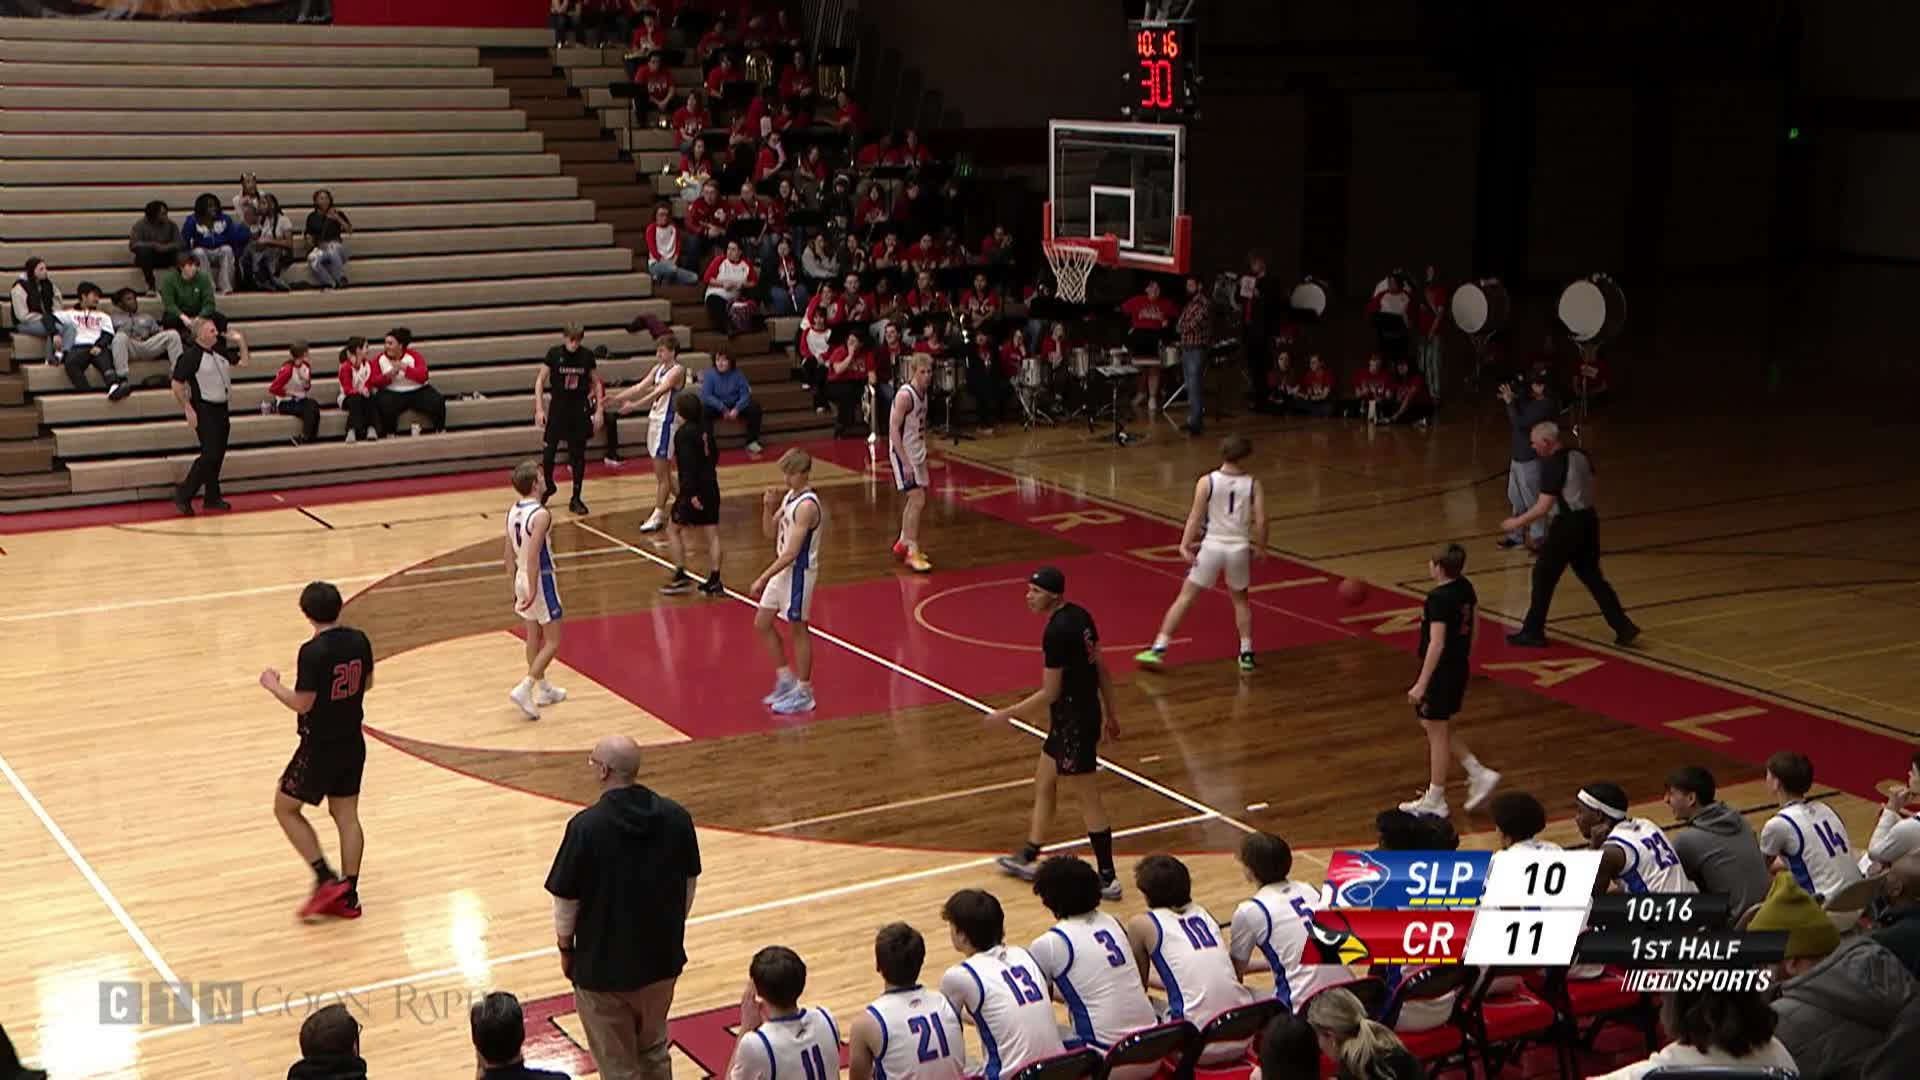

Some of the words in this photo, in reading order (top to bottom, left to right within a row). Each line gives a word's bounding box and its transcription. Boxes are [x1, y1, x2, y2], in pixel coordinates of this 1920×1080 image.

[1137, 30, 1178, 58] 10:16
[1141, 60, 1172, 107] 30
[1229, 490, 1236, 514] 1
[331, 658, 363, 701] 20
[1641, 832, 1679, 871] 23
[1814, 820, 1848, 858] 14
[1093, 929, 1127, 968] 3
[1178, 916, 1218, 950] 10
[1000, 965, 1044, 1007] 13
[907, 1012, 950, 1064] 21
[801, 1044, 826, 1080] 11
